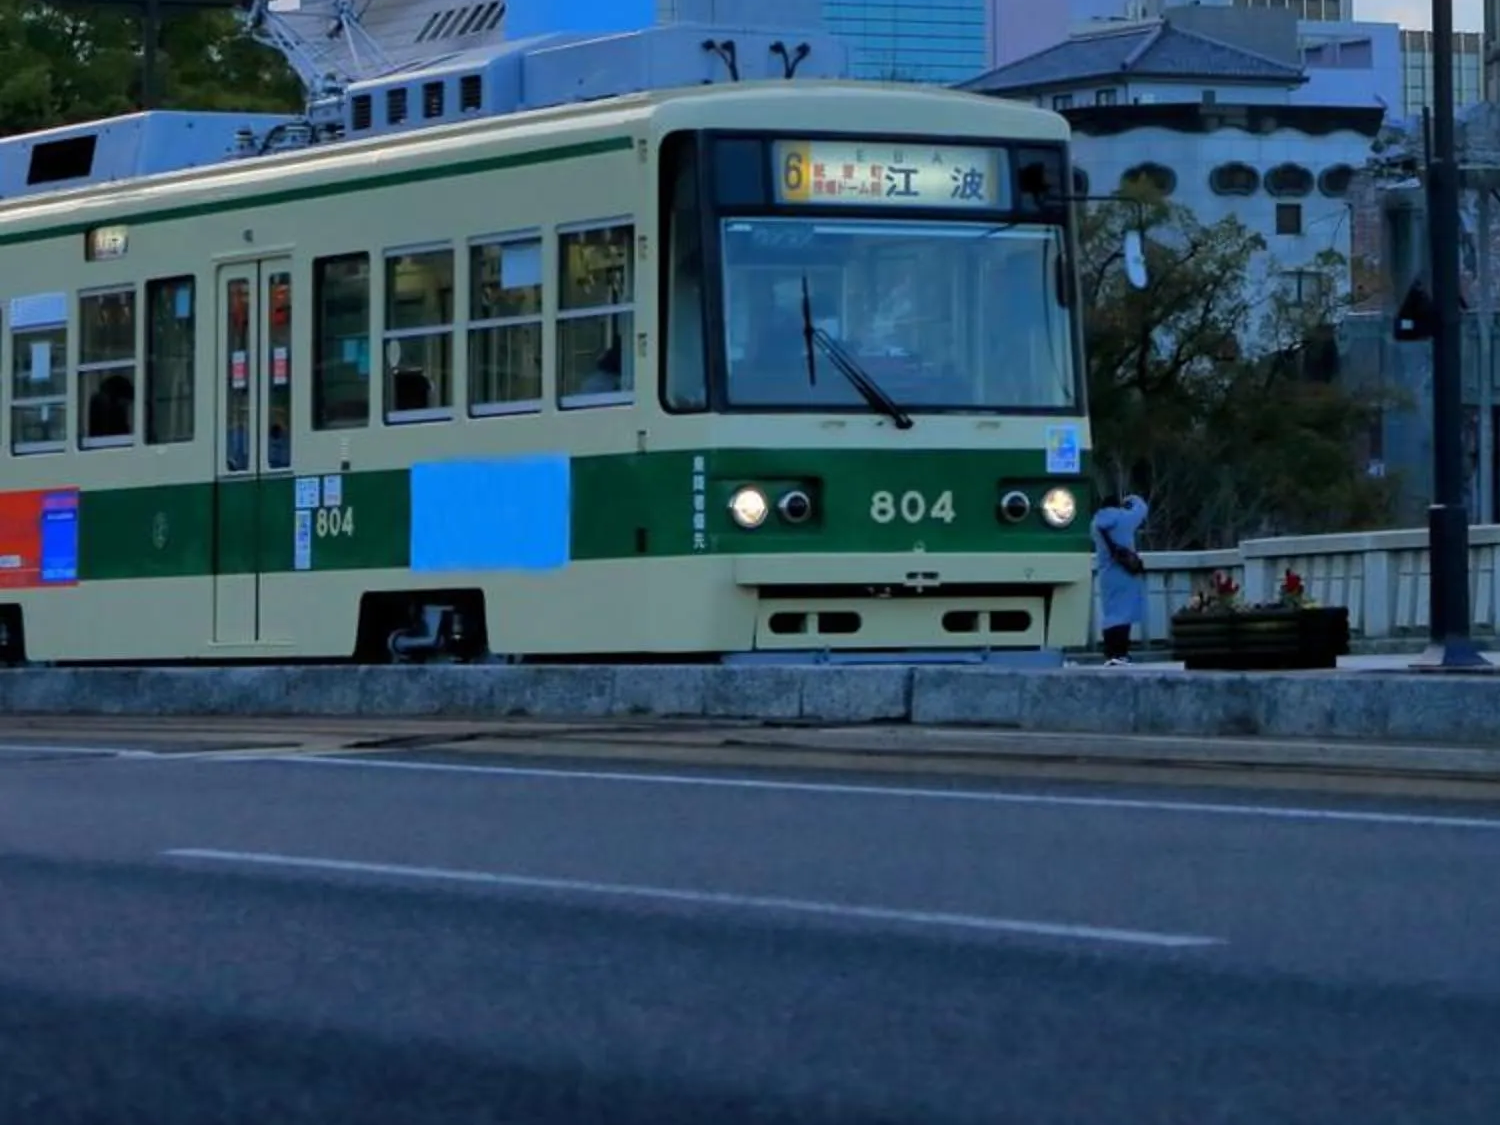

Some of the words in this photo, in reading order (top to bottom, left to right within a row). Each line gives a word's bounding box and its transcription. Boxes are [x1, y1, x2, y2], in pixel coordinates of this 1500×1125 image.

[784, 152, 803, 191] 6
[885, 166, 985, 201] 江波
[316, 506, 355, 537] 804
[870, 489, 956, 524] 804
